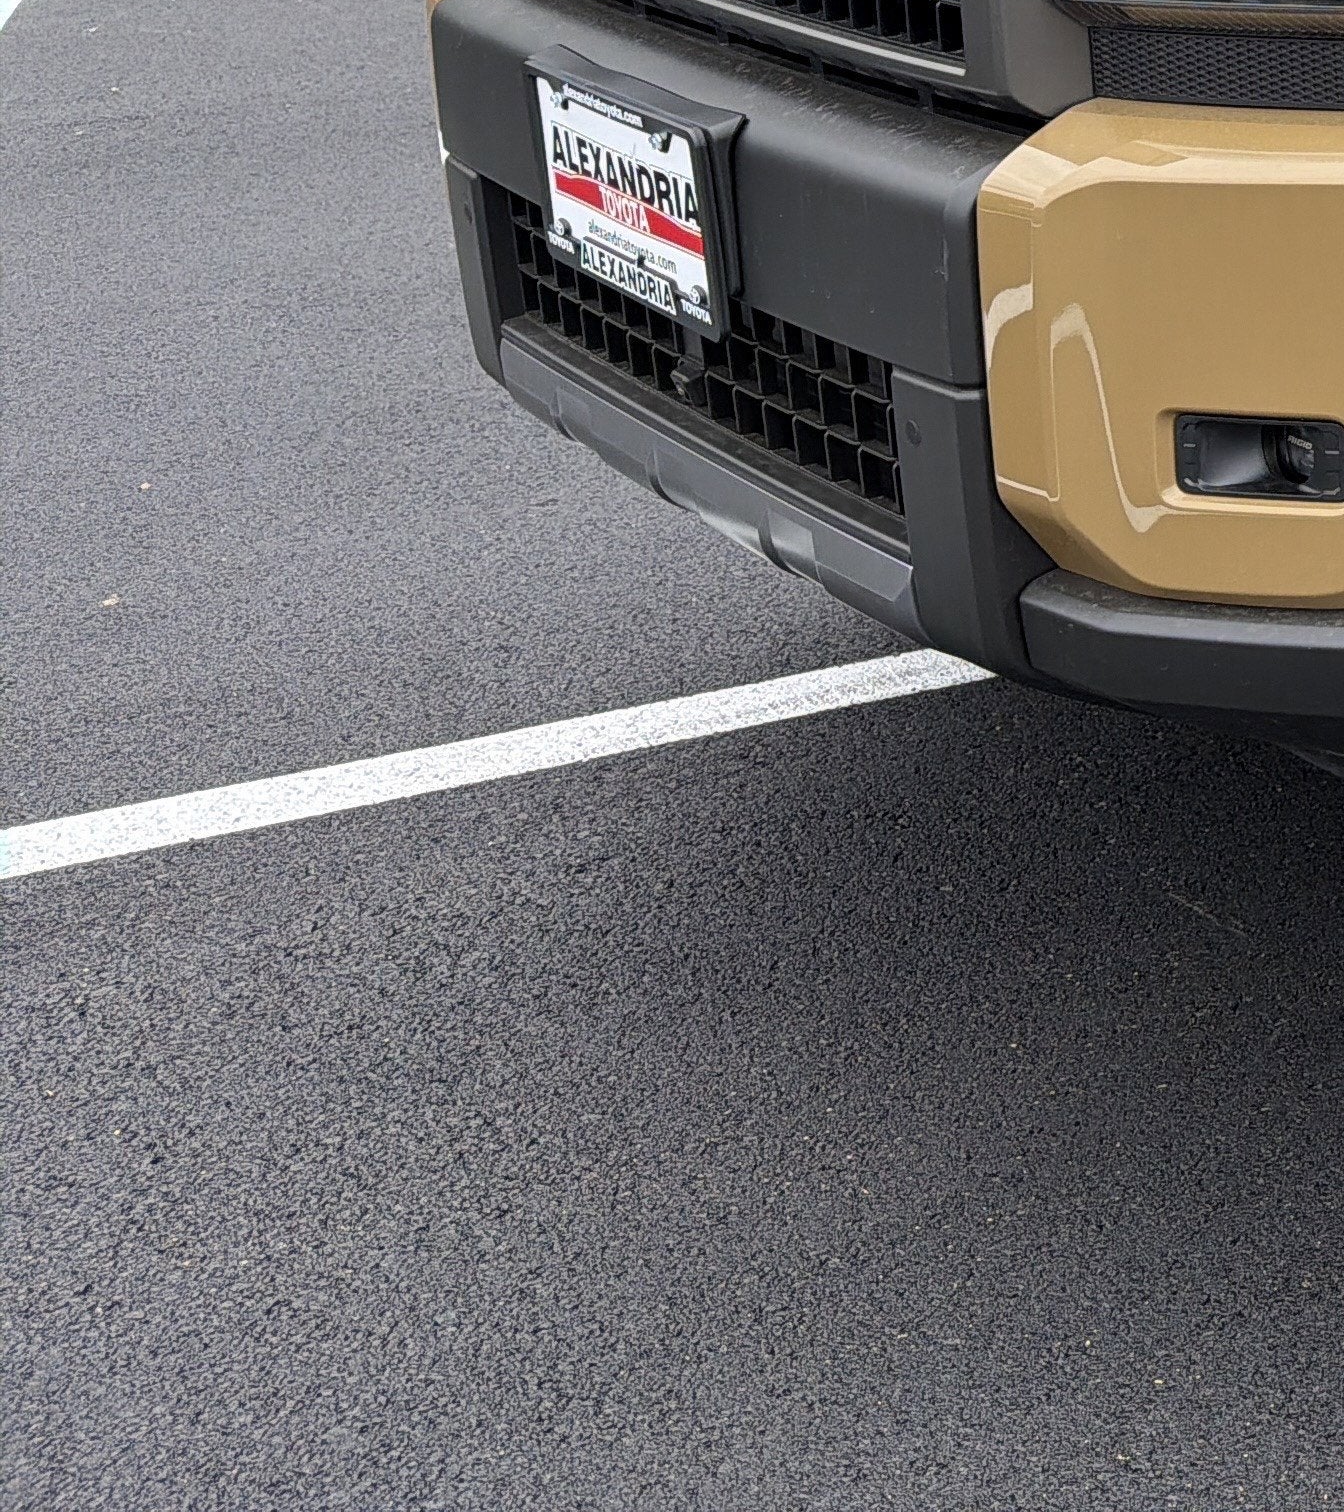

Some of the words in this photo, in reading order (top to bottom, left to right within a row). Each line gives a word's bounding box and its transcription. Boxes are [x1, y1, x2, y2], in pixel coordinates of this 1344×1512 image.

[552, 125, 701, 223] ALEXANDRIA
[598, 185, 651, 234] TOYOTA
[547, 230, 575, 255] TOYOTA
[588, 218, 678, 275] alexandriatoyota.com
[581, 241, 676, 314] ALEXANDRIA
[680, 298, 713, 327] TOYOTA
